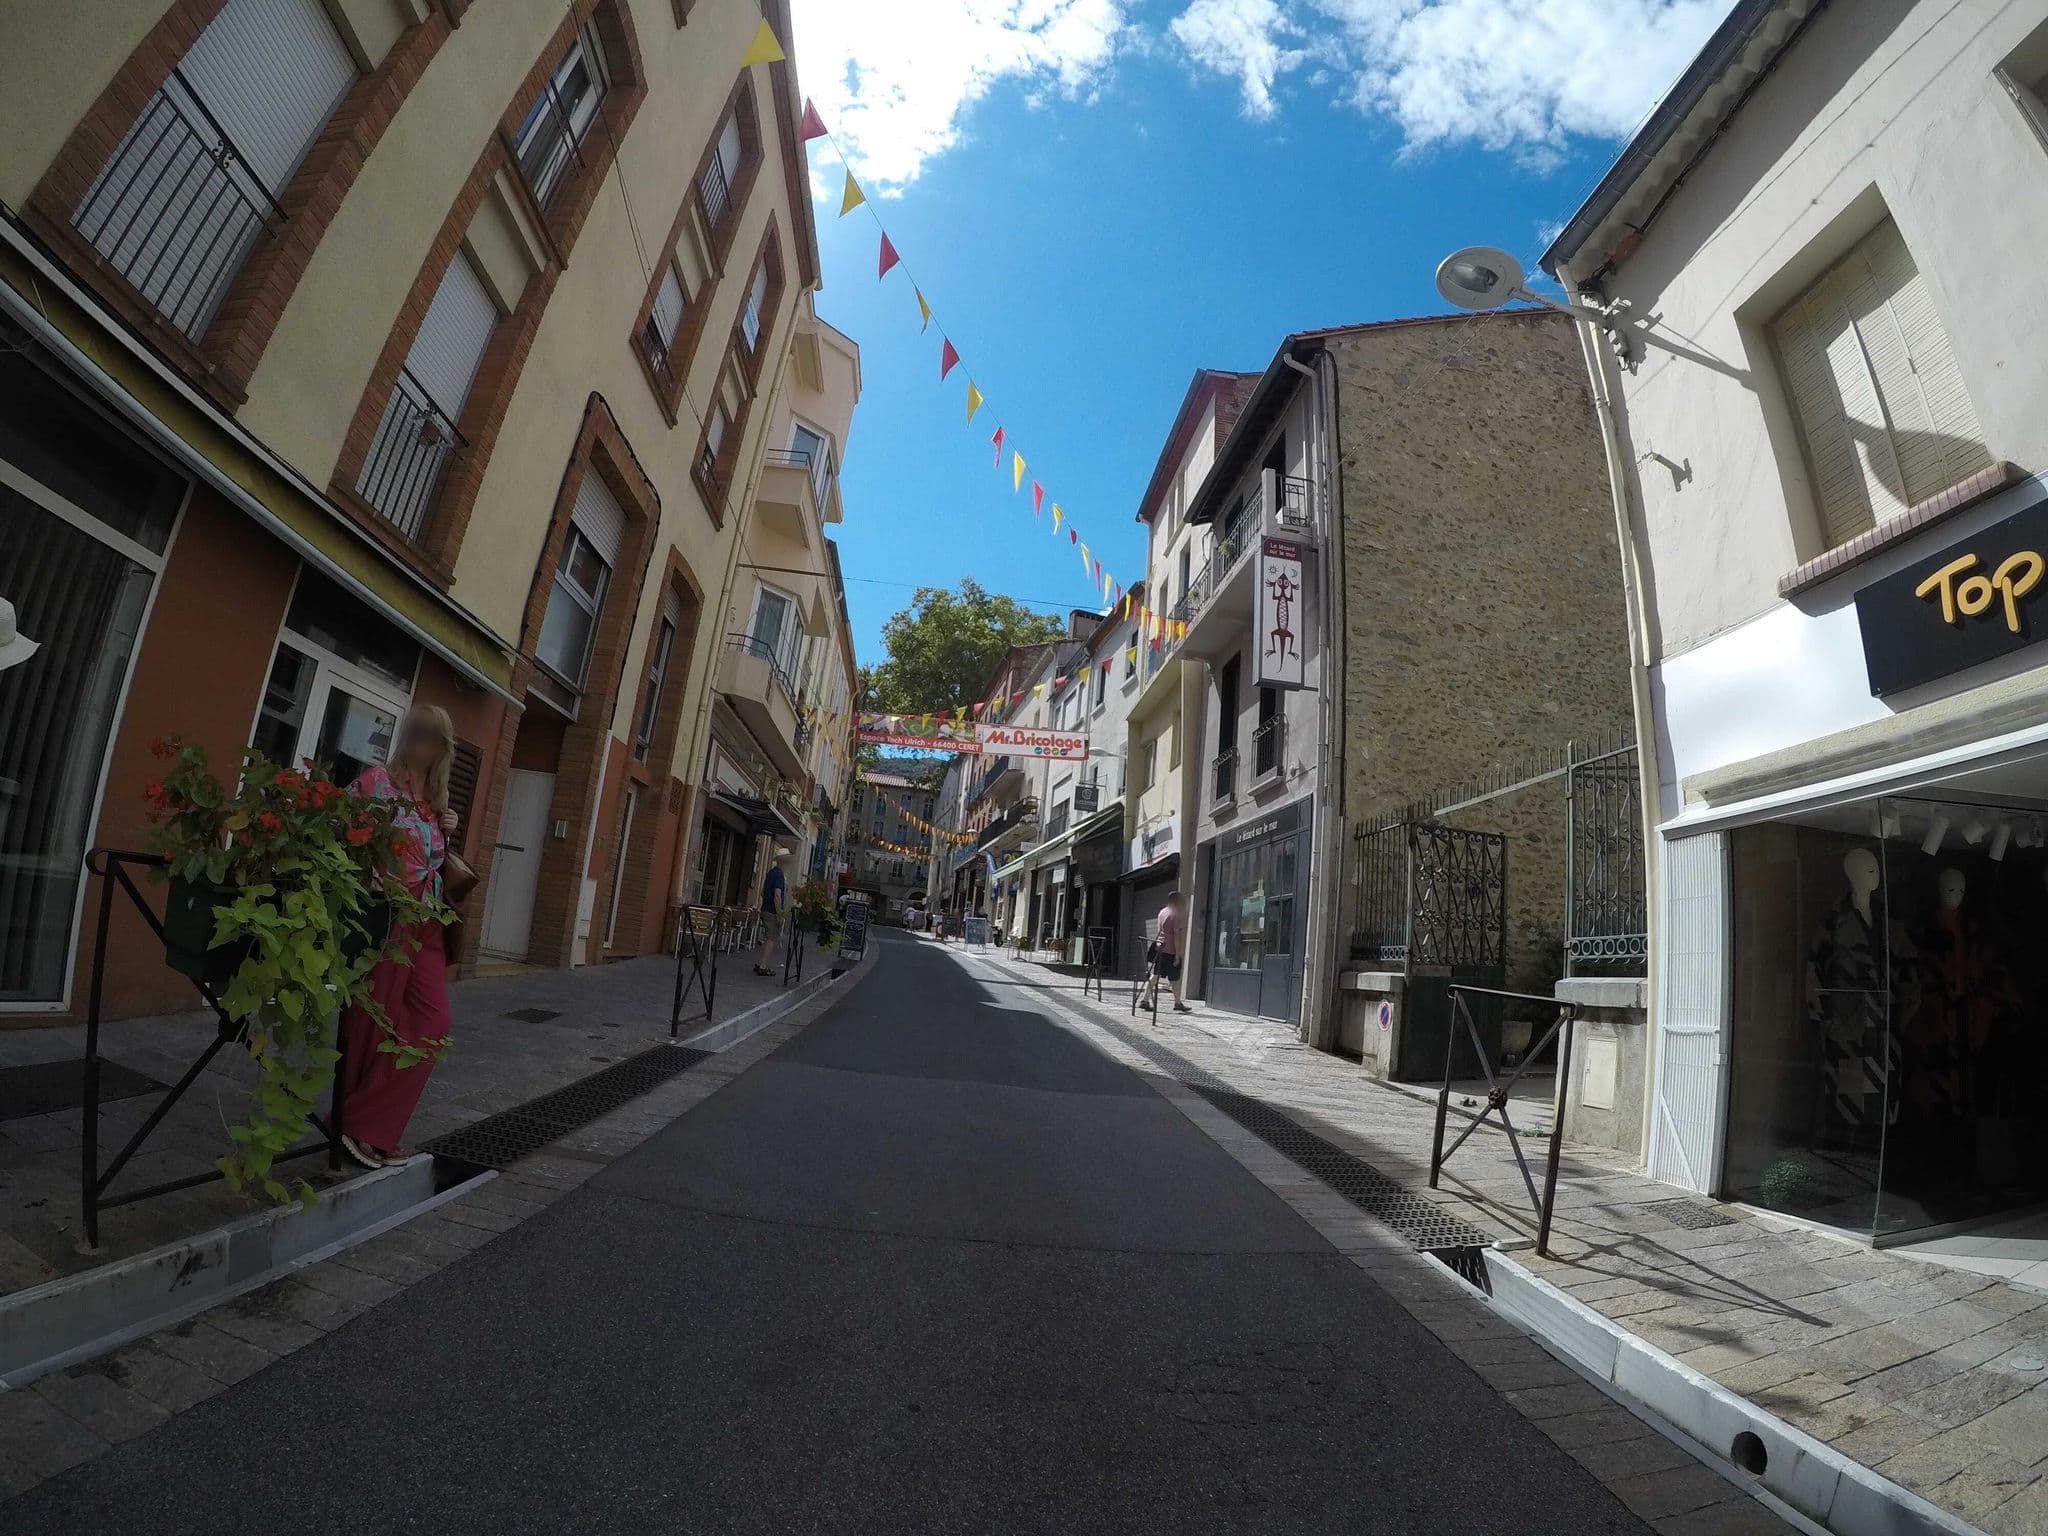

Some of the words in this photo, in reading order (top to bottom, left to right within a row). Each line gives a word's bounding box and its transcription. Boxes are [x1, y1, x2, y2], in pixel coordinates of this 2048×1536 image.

[1915, 550, 2046, 633] Top
[859, 733, 886, 743] Espace
[904, 737, 927, 747] Ulrich
[932, 740, 957, 749] 66400
